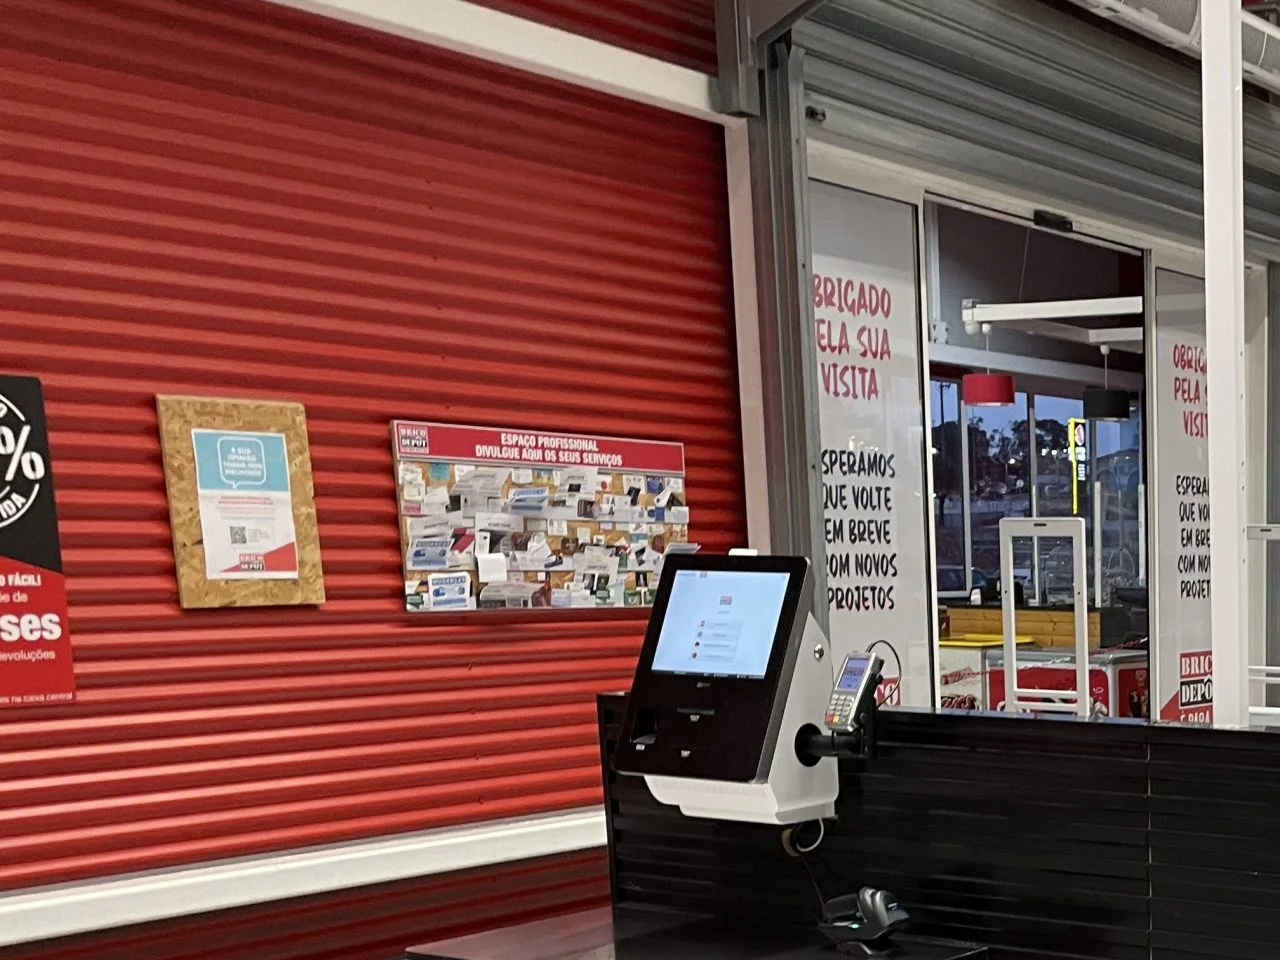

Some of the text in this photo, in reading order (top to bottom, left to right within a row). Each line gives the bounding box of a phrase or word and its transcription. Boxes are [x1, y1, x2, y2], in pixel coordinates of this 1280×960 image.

[813, 273, 891, 319] BRIGADO
[816, 317, 891, 360] ELA SUA
[1173, 344, 1207, 375] OBRIG
[821, 362, 878, 400] VISITA
[1174, 377, 1200, 404] PELA
[475, 444, 622, 468] DIVULGUE AQUI OS SEUS SERVIÇOS
[501, 433, 599, 452] ESPAÇO PROFISSIONAL
[821, 449, 895, 478] SPERAMOS
[852, 485, 892, 512] VOLTE
[1176, 475, 1209, 496] ESPERA
[1179, 501, 1195, 522] QUE
[825, 518, 891, 545] EM BREVE
[1181, 528, 1192, 548] EM
[826, 553, 897, 578] OM NOVOS
[1178, 554, 1211, 573] COM NO
[8, 572, 41, 587] FÁCIL!
[828, 585, 894, 612] PROJETOS
[0, 613, 62, 641] ses
[1181, 655, 1212, 675] BRIC
